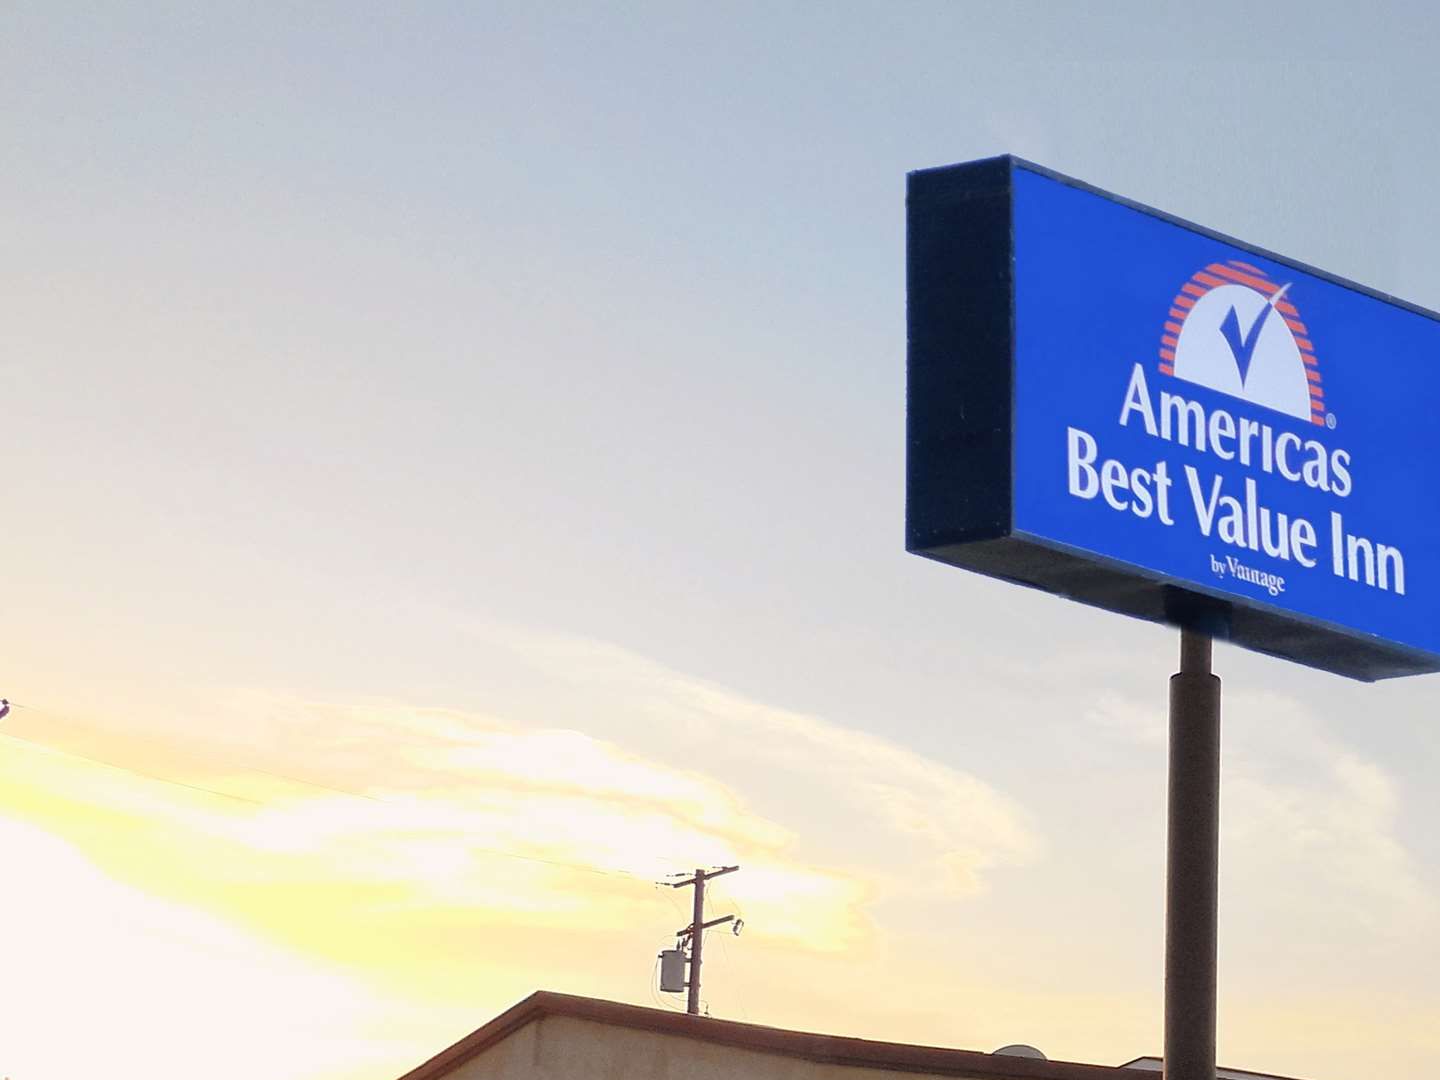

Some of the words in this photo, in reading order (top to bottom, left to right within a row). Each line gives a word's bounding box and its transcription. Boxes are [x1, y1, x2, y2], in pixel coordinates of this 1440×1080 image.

[1119, 362, 1353, 498] Americas
[1067, 426, 1175, 526] Best
[1183, 463, 1318, 569] Value
[1329, 510, 1406, 597] Inn
[1209, 552, 1227, 580] by
